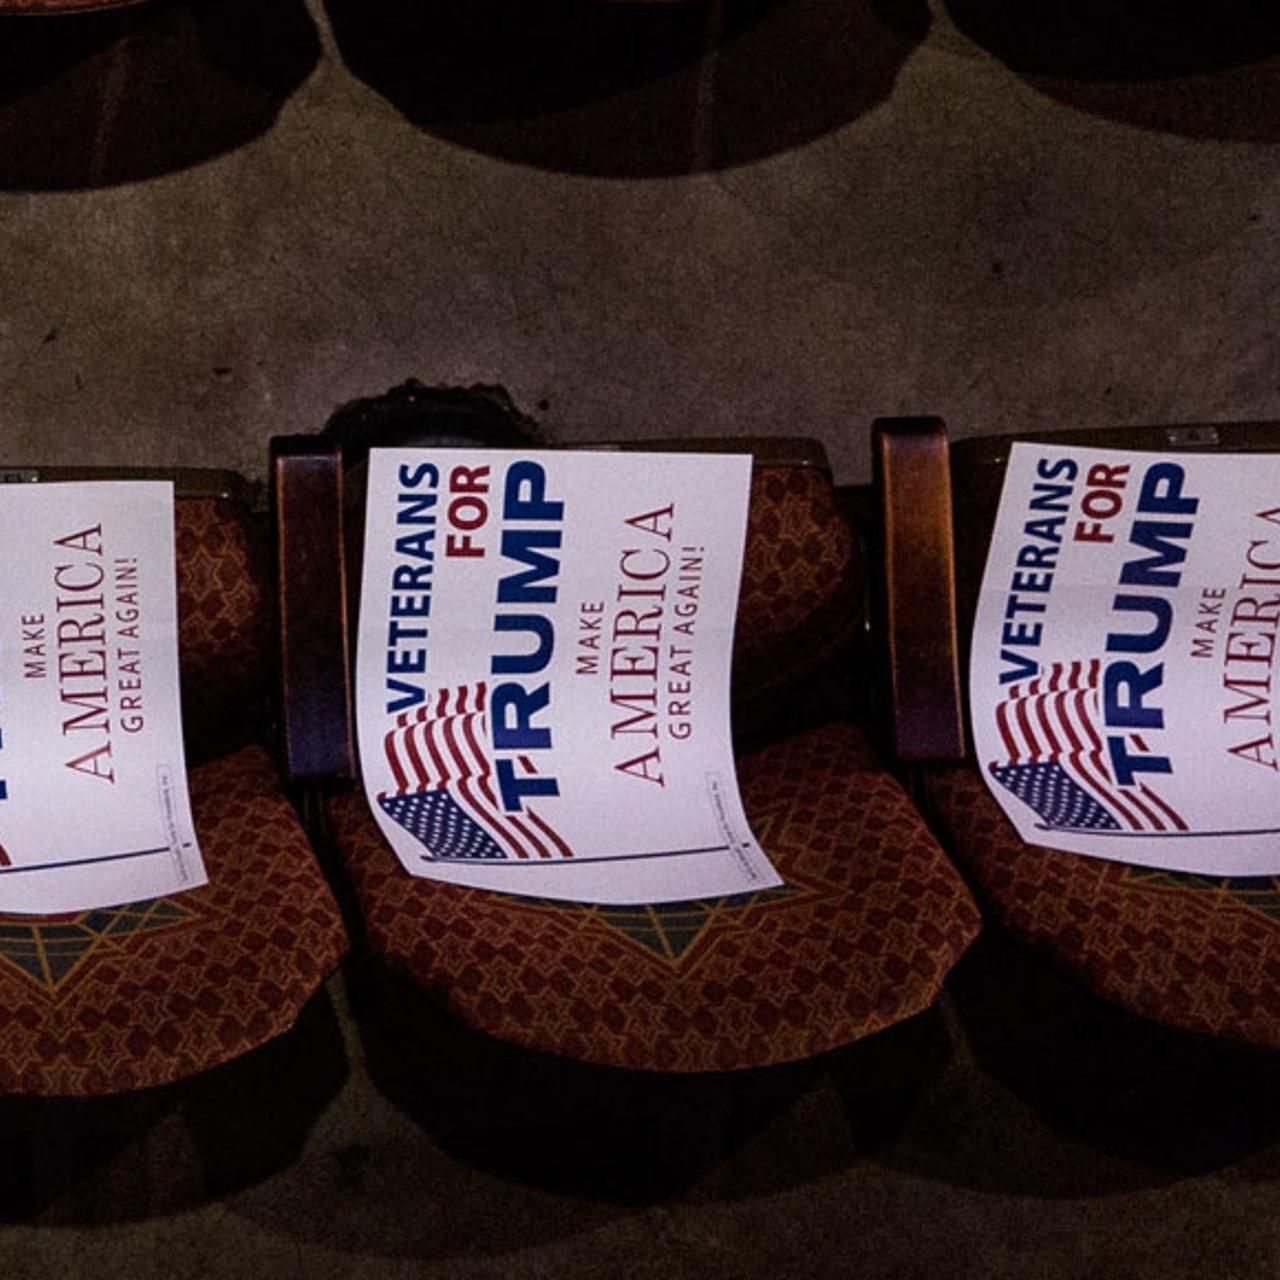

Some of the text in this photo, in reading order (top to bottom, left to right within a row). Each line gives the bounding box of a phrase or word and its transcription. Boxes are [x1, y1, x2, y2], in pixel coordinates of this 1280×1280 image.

[386, 462, 439, 714] VETERANS
[446, 465, 490, 558] FOR
[999, 457, 1079, 685] VETERANS
[1073, 462, 1130, 544] FOR
[22, 613, 46, 679] MAKE
[53, 523, 115, 784] AMERICA
[114, 557, 144, 734] GREAT AGAIN!
[490, 460, 565, 813] TRUMP
[576, 600, 605, 676] MAKE
[610, 503, 675, 787] AMERICA
[667, 545, 705, 740] GREAT AGAIN!
[1103, 461, 1199, 787] TRUMP
[1190, 586, 1226, 659] MAKE
